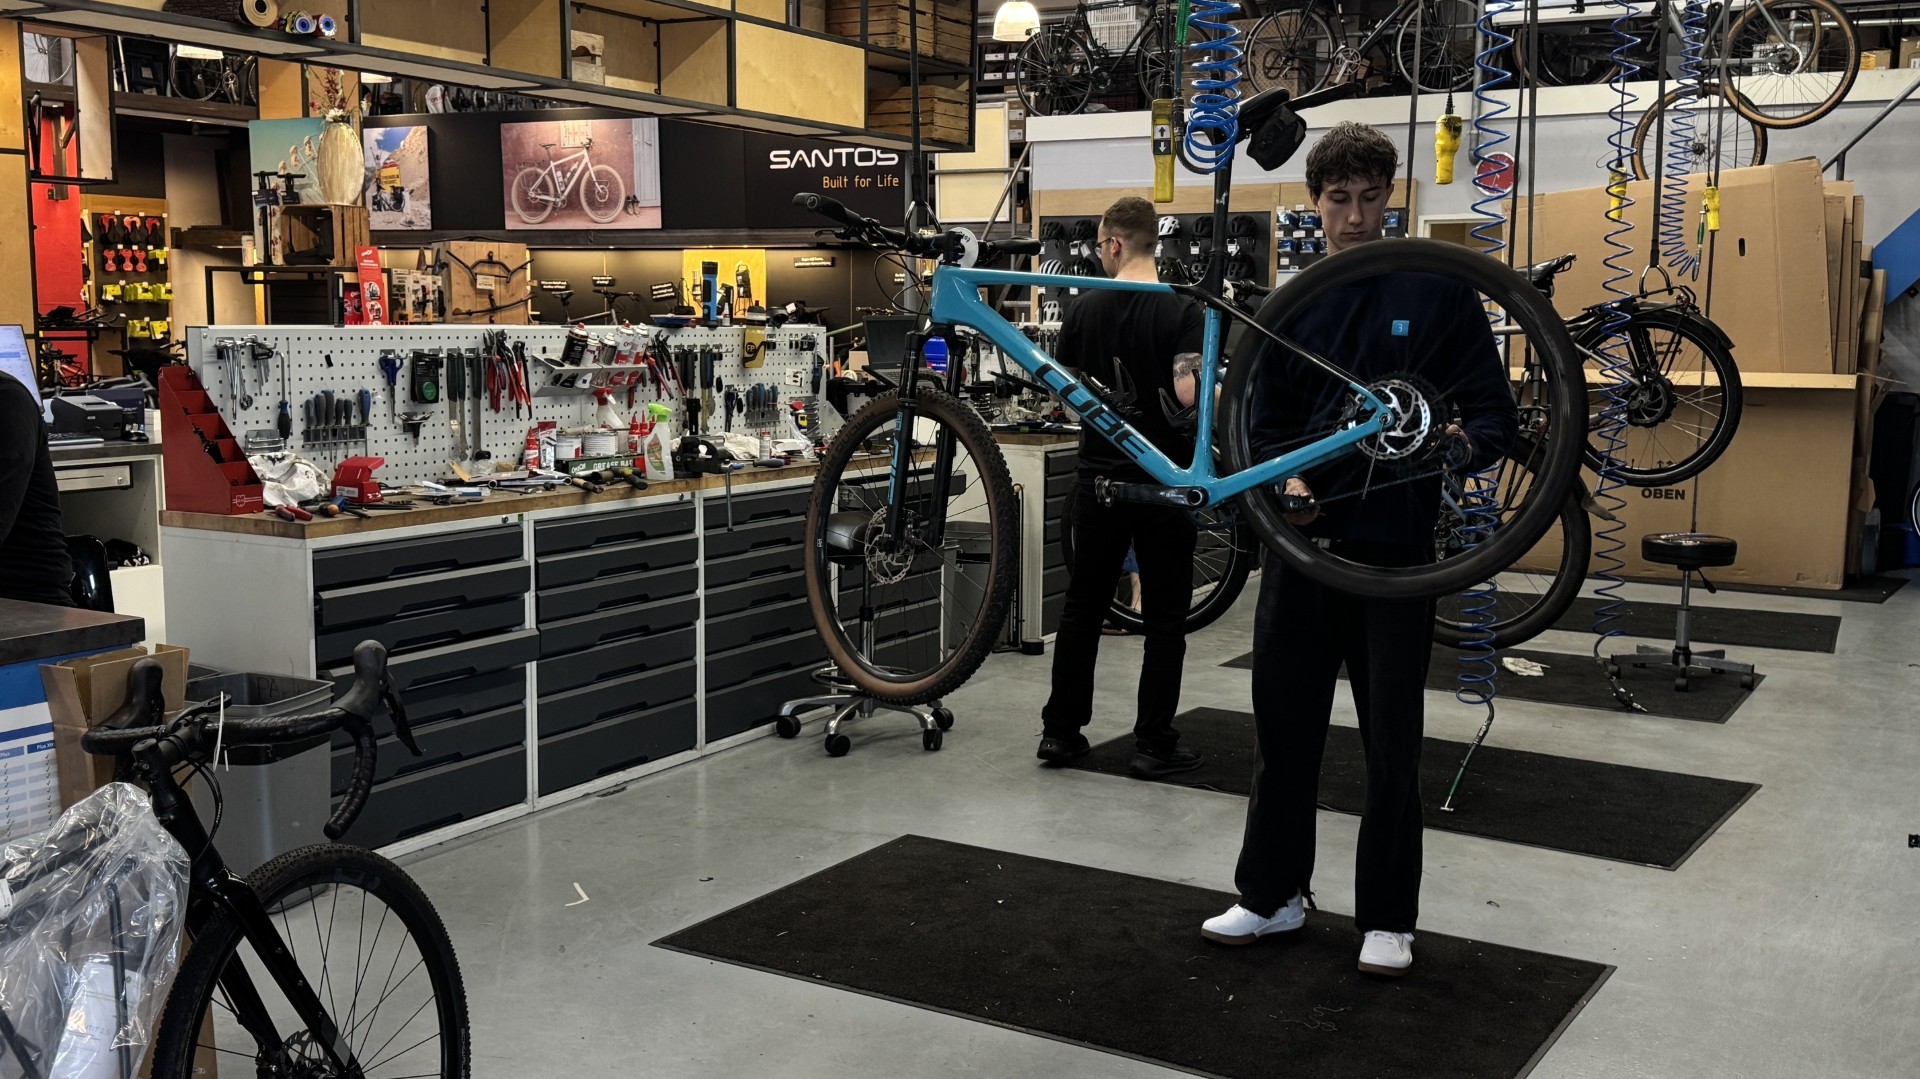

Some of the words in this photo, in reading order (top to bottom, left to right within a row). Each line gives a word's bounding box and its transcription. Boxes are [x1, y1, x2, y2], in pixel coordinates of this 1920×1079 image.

[769, 147, 899, 169] SANTOS
[823, 175, 848, 188] Built
[855, 175, 871, 187] for
[878, 174, 899, 187] Life
[1035, 363, 1152, 460] CUBE
[593, 461, 619, 471] GREASE
[1641, 488, 1686, 500] OBEN
